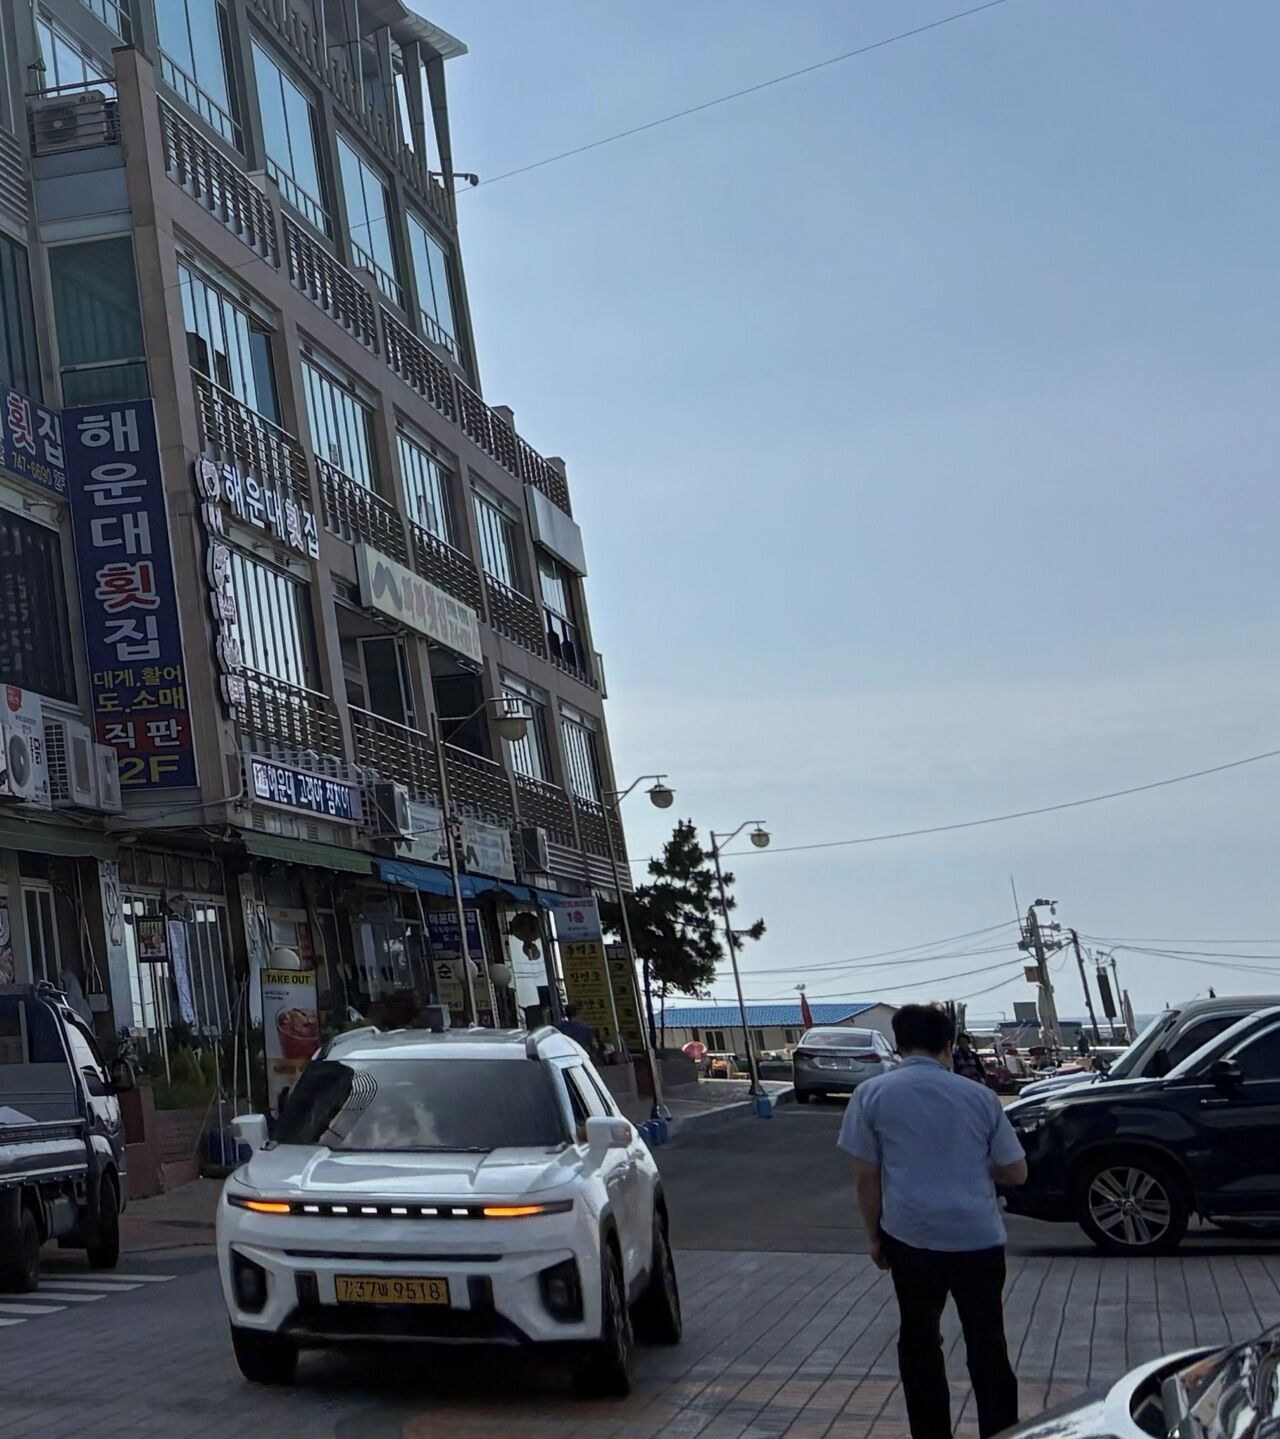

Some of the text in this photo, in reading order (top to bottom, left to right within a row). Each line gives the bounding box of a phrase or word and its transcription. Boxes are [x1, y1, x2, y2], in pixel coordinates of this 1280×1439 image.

[76, 407, 162, 663] 해운대횟집
[222, 463, 320, 561] 해운대횟집
[118, 754, 180, 785] 2F
[266, 974, 311, 985] TAKE OUT
